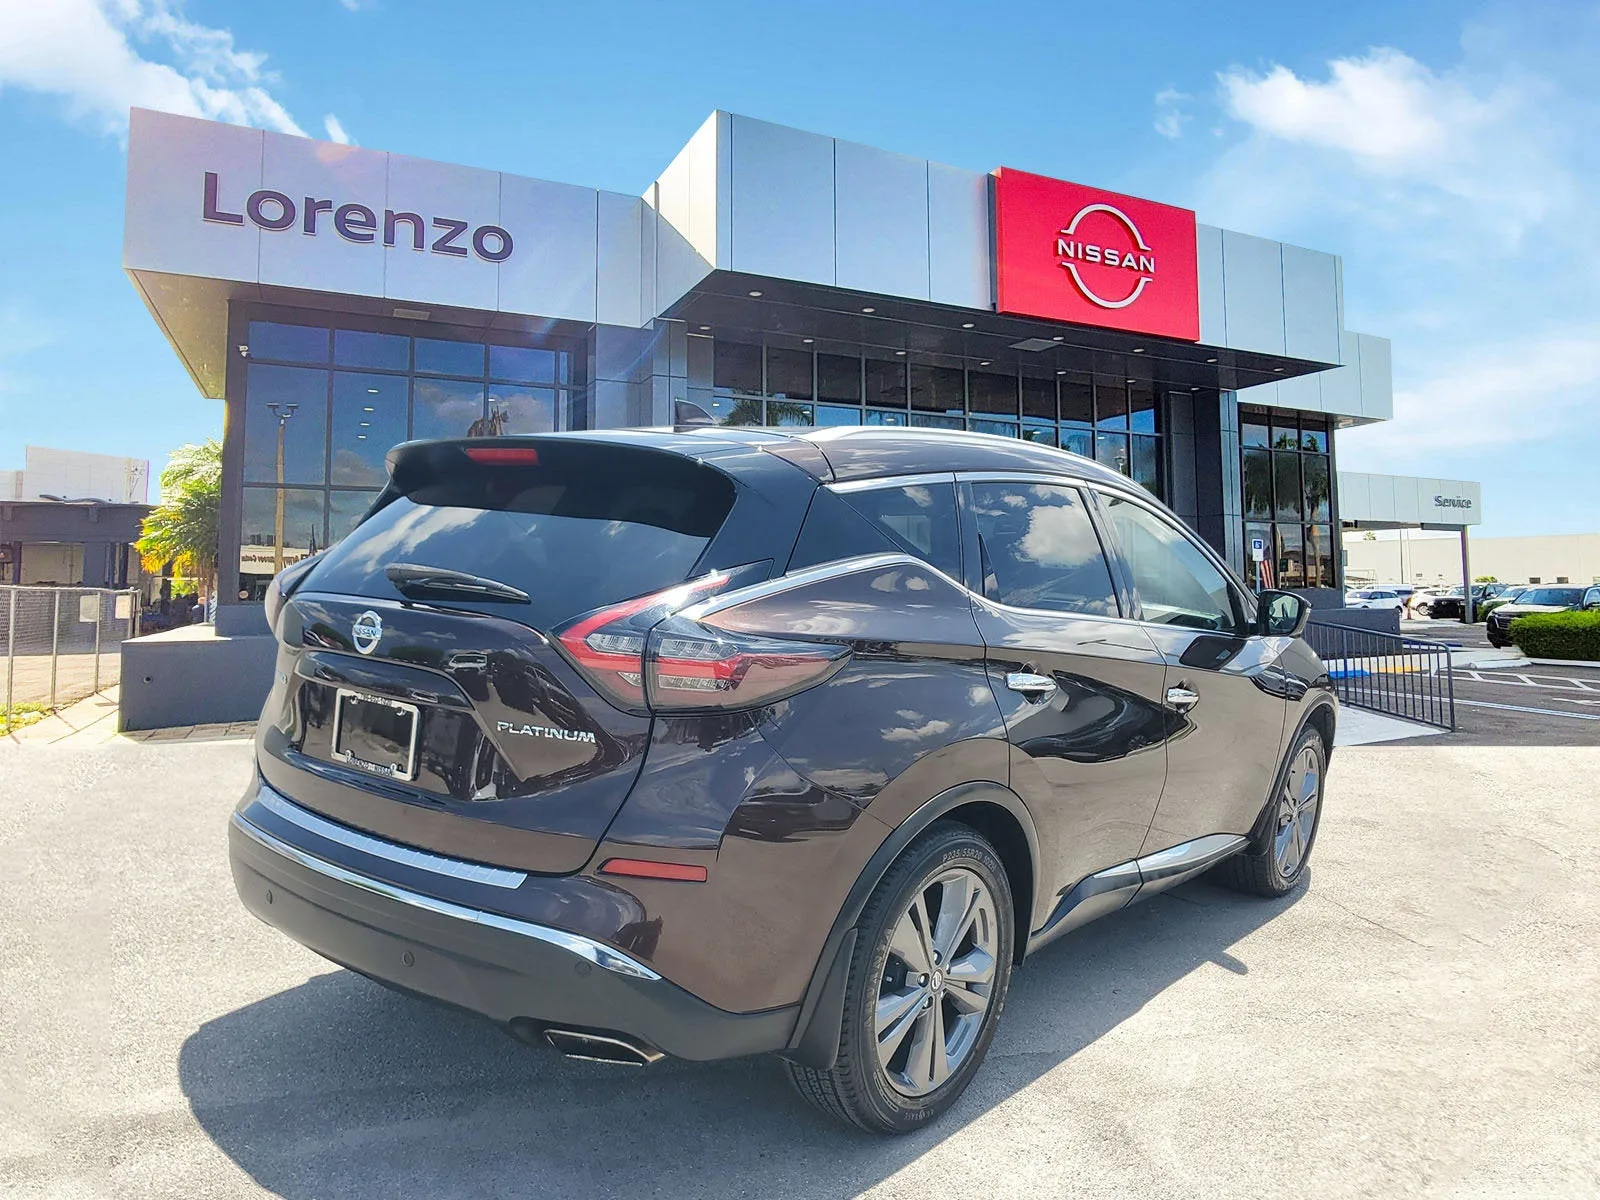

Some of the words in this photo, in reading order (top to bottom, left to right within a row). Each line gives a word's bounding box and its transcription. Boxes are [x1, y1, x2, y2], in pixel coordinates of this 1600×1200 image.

[202, 171, 515, 262] Lorenzo
[1057, 237, 1155, 273] NISSAN
[1434, 495, 1472, 509] Service
[497, 721, 596, 743] PLATINUM
